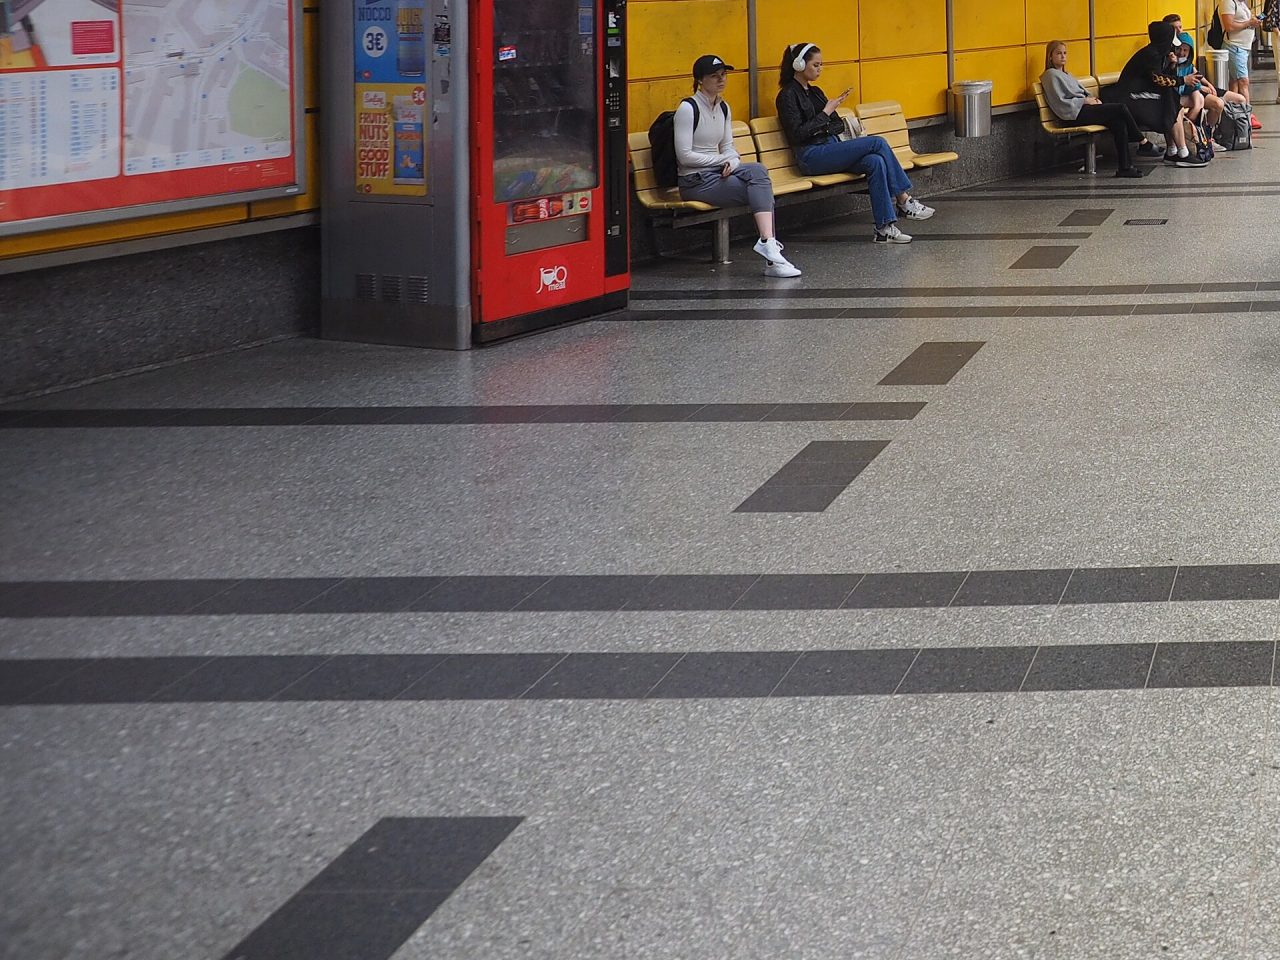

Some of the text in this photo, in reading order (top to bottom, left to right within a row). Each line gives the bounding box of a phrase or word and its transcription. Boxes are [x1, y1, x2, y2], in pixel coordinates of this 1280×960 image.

[358, 7, 391, 21] NOCCO
[366, 33, 384, 51] 3€
[359, 112, 388, 124] FRUITS
[359, 125, 389, 141] NUTS
[359, 149, 389, 162] GOOD
[359, 162, 389, 178] STUFF
